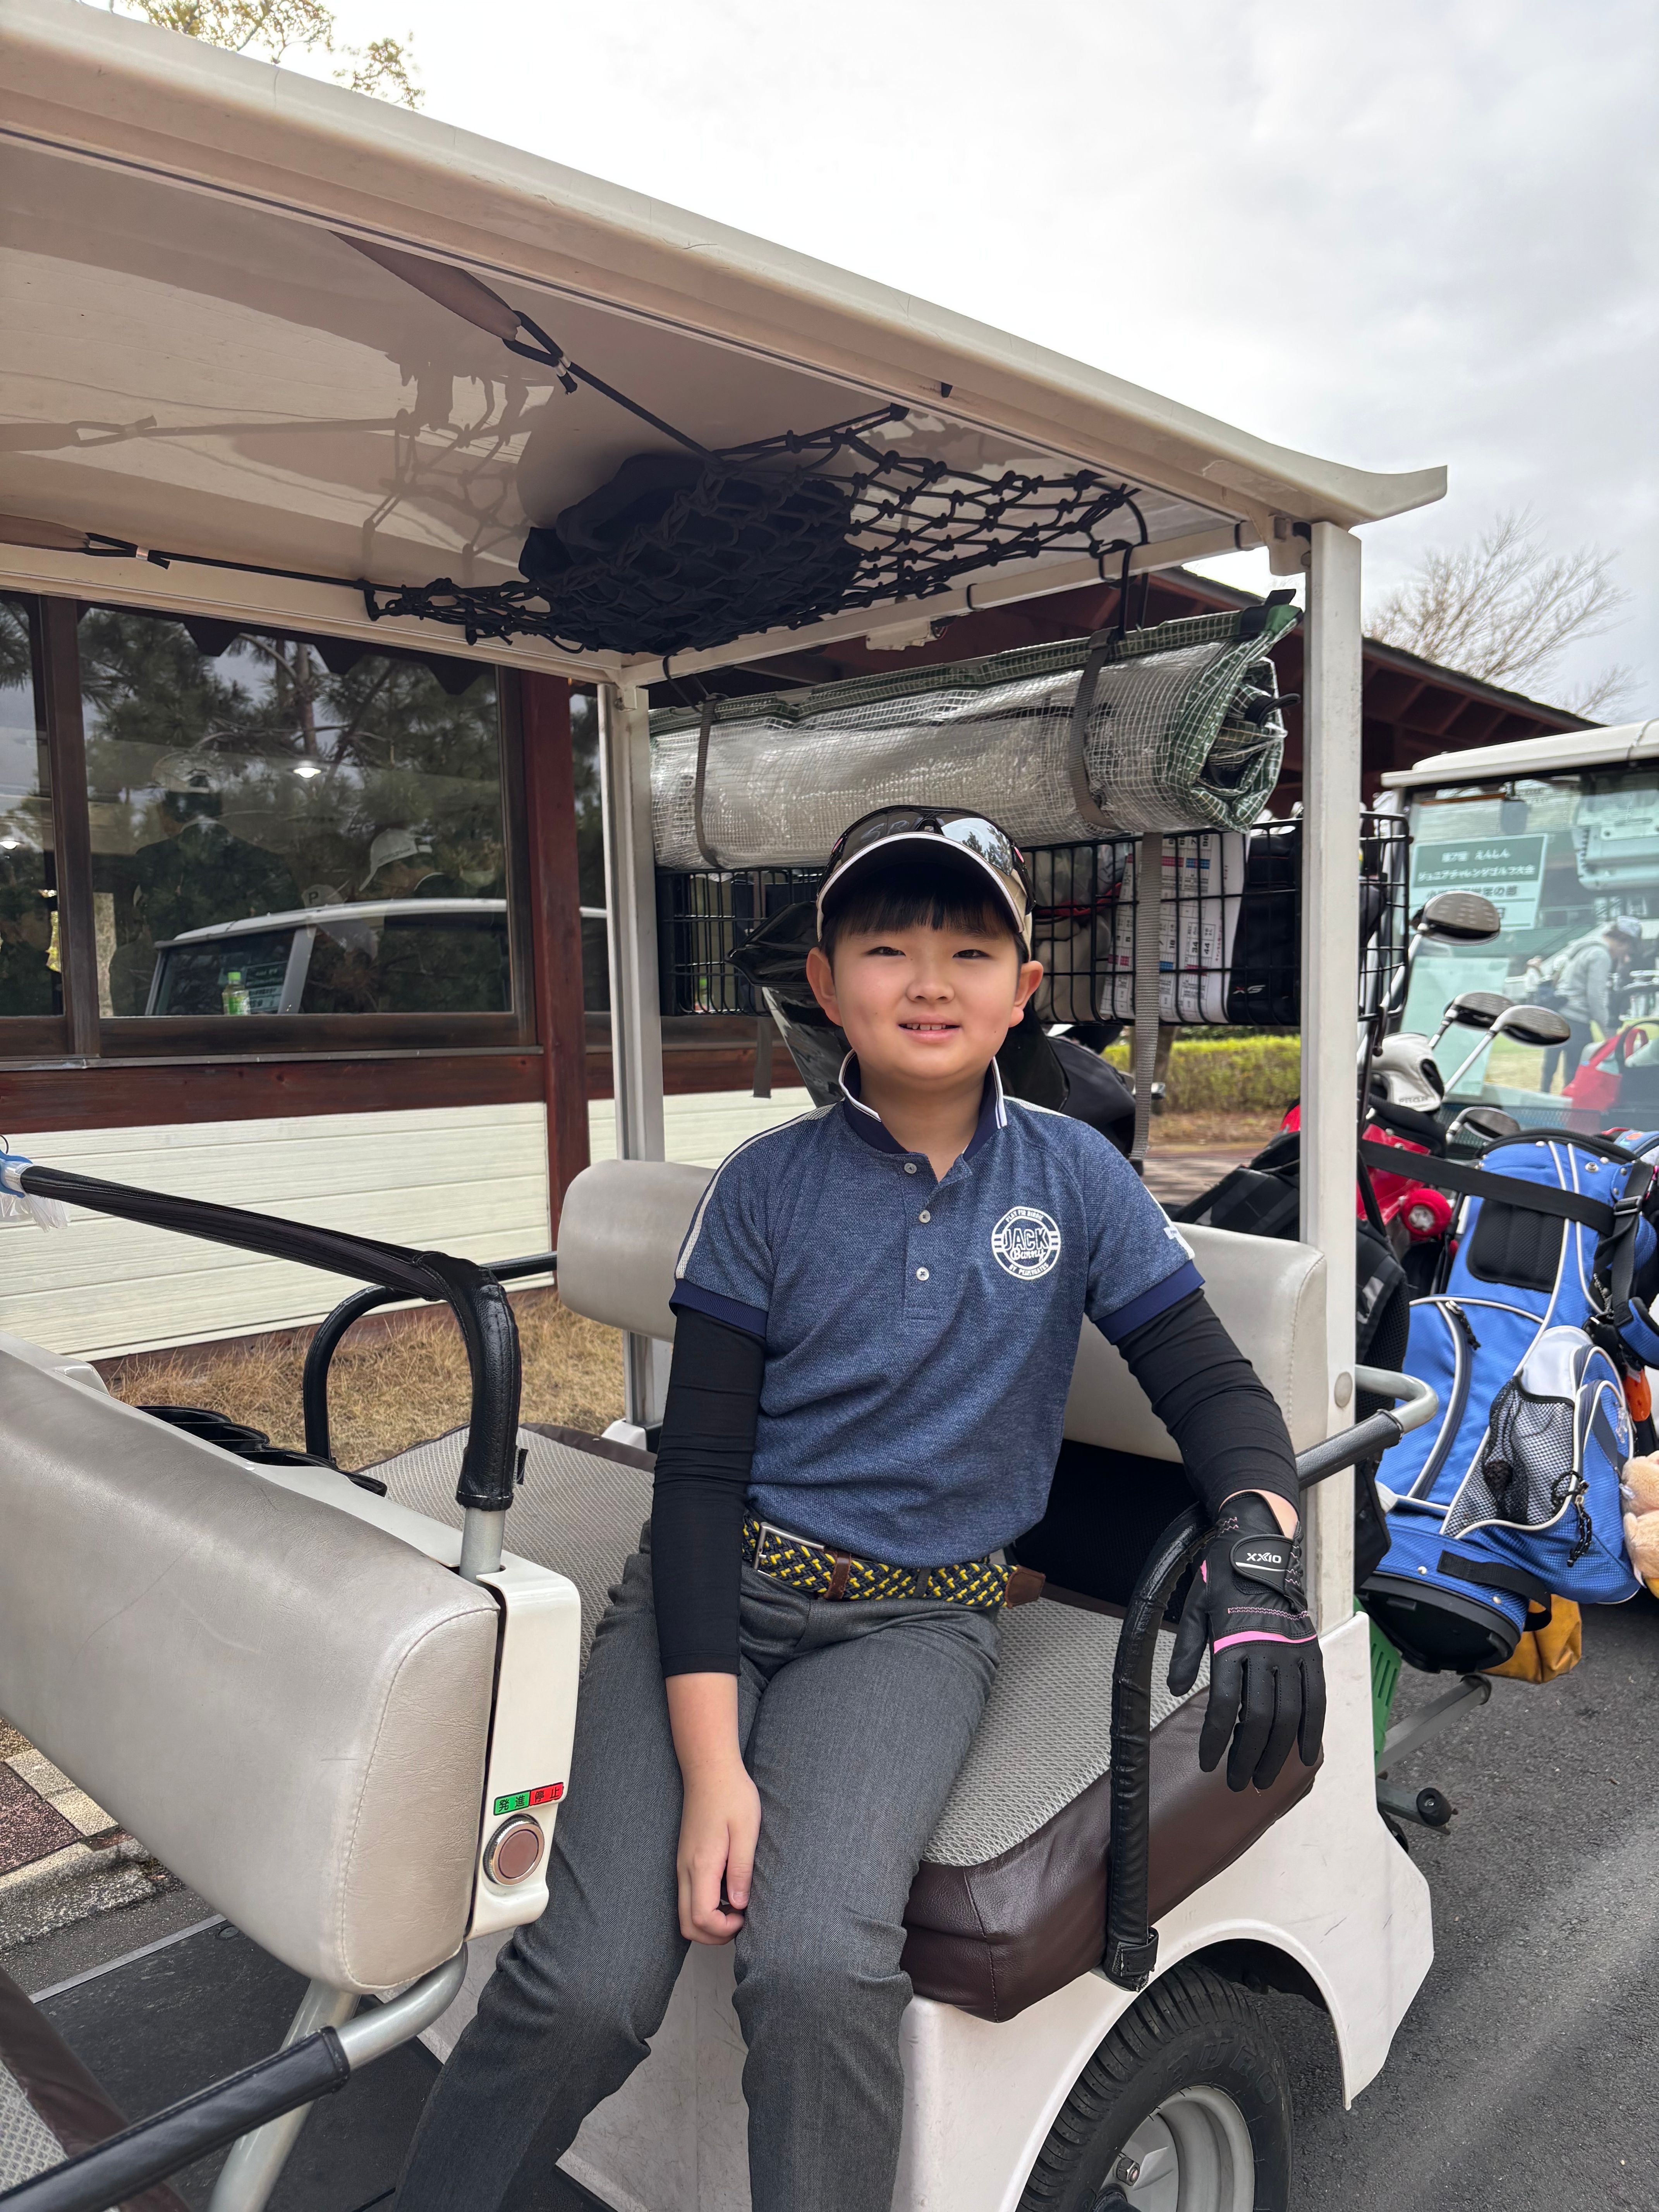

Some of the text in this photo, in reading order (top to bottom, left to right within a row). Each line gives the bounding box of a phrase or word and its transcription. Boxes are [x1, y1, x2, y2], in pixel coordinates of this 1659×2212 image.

[1203, 943, 1210, 955] 44
[1003, 1227, 1049, 1251] JACK
[1010, 1247, 1046, 1262] Bunny
[1246, 1552, 1282, 1564] XXIO
[498, 1787, 560, 1812] 発進 停止
